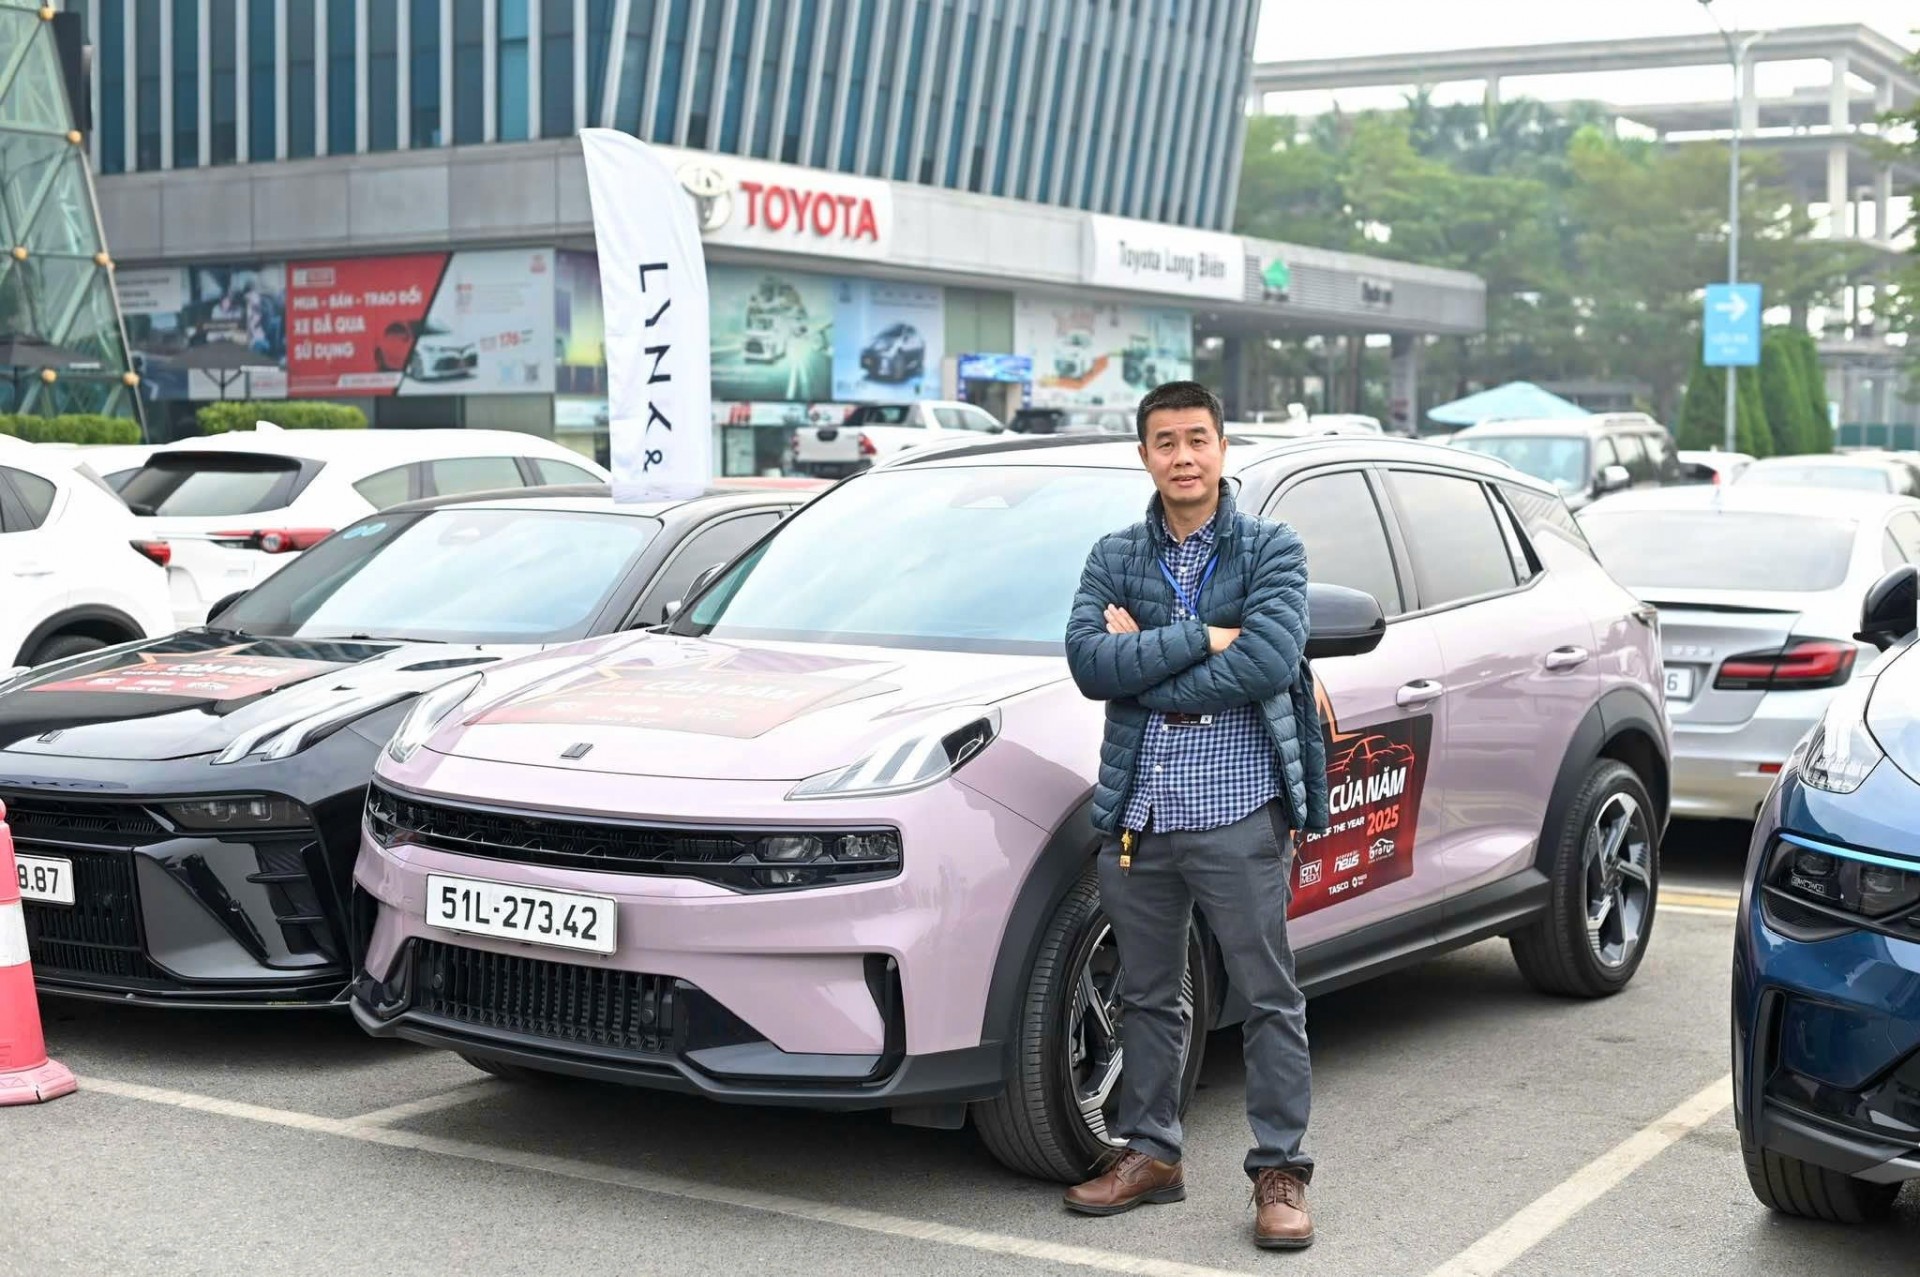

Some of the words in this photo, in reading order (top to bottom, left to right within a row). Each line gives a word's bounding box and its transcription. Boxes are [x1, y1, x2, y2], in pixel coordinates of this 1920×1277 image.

[739, 181, 878, 241] TOYOTA
[1118, 239, 1161, 276] Toyota
[1164, 247, 1195, 282] Long
[364, 290, 397, 307] TRAO
[639, 262, 673, 435] LYNK
[643, 449, 663, 473] &
[1329, 775, 1365, 815] CỦA
[1365, 766, 1407, 804] NĂM
[1333, 821, 1347, 834] THE
[1347, 815, 1366, 829] YEAR
[1366, 804, 1400, 837] 2025
[1328, 881, 1349, 896] TASCO
[442, 885, 598, 942] 51L-273.42
